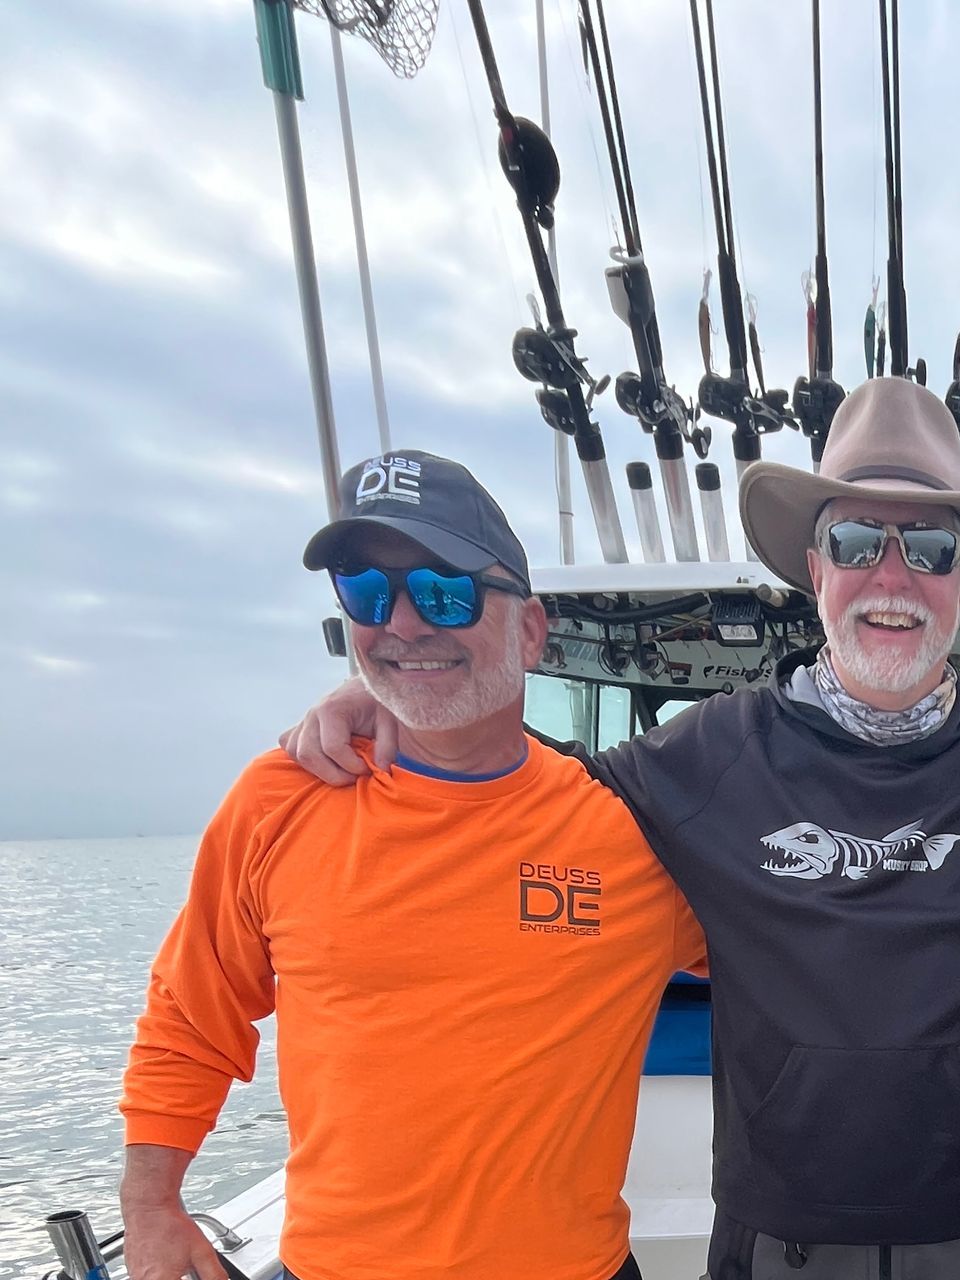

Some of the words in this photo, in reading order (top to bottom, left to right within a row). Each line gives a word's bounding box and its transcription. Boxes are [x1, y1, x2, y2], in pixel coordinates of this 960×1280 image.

[356, 466, 421, 498] DE
[519, 862, 601, 885] DEUSS
[519, 880, 601, 927] DE
[519, 922, 601, 936] ENTERPRISES
